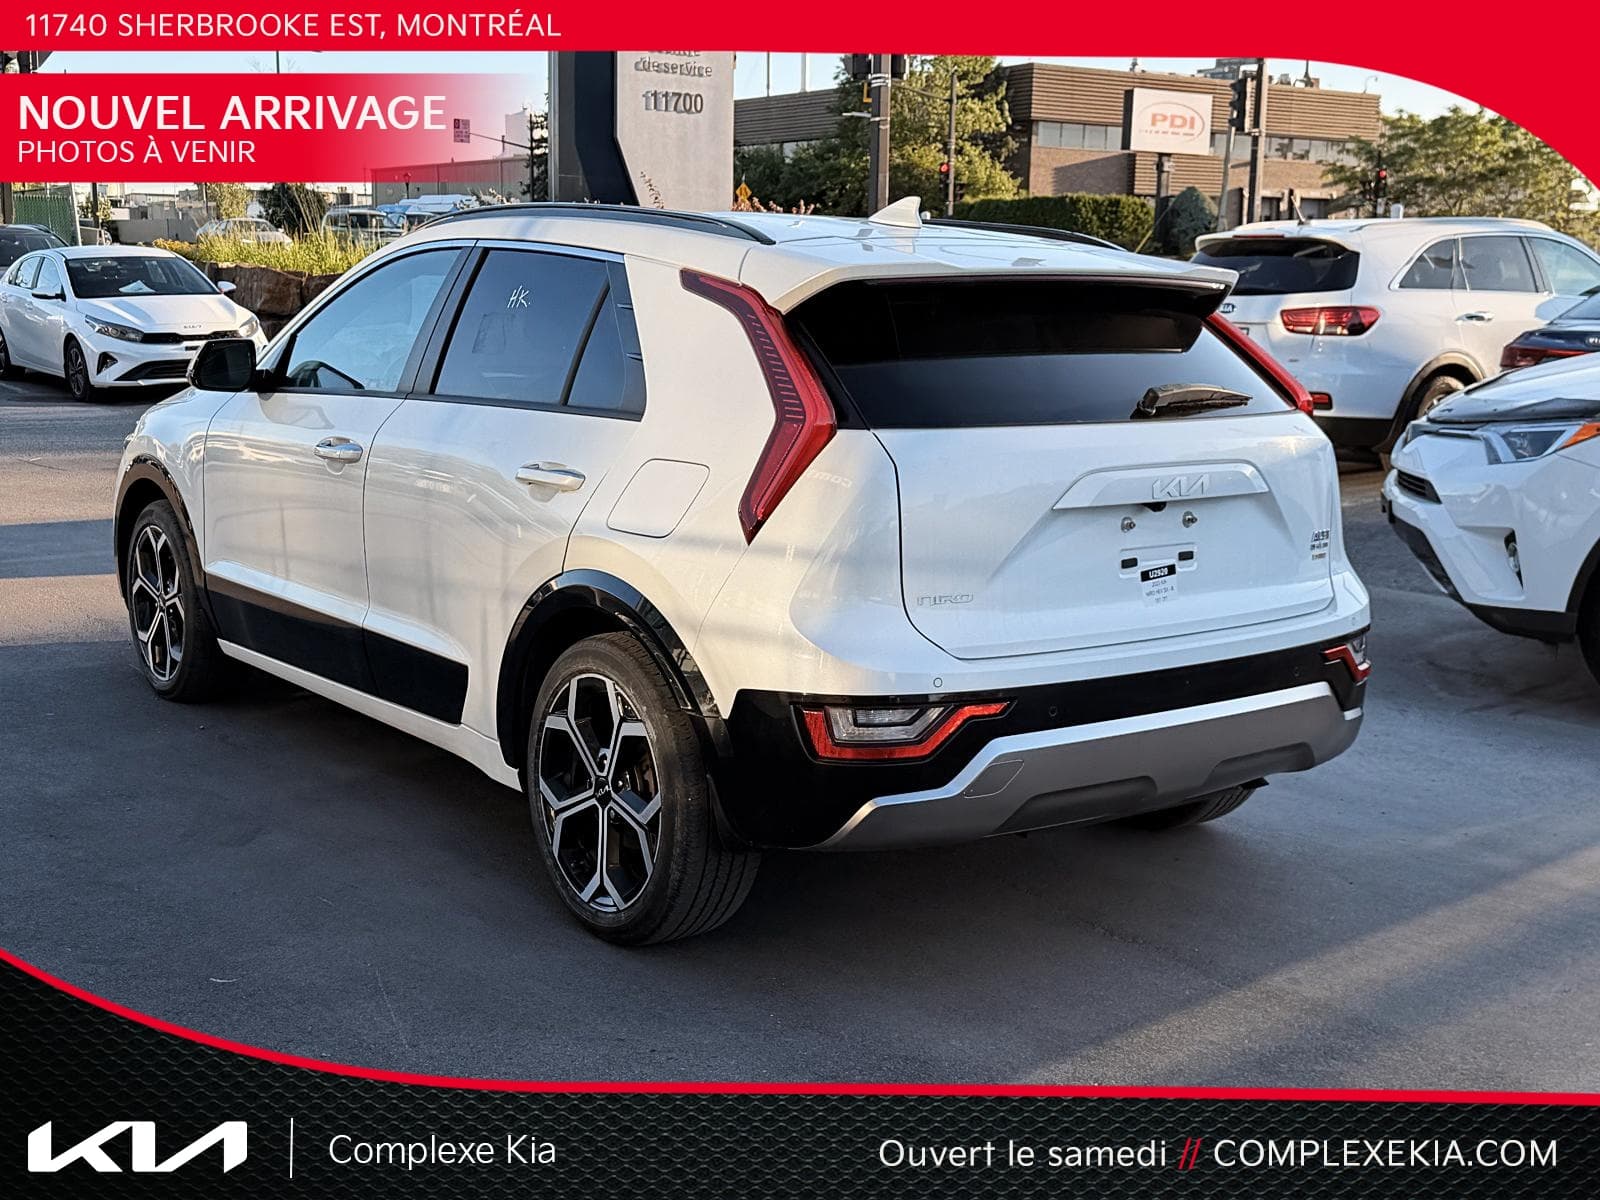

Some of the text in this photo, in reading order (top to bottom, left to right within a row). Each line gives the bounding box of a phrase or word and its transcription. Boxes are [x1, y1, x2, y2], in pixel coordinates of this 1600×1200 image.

[662, 61, 713, 78] service
[648, 90, 704, 114] 11700
[1151, 112, 1195, 129] PDI
[917, 594, 974, 607] NIRO
